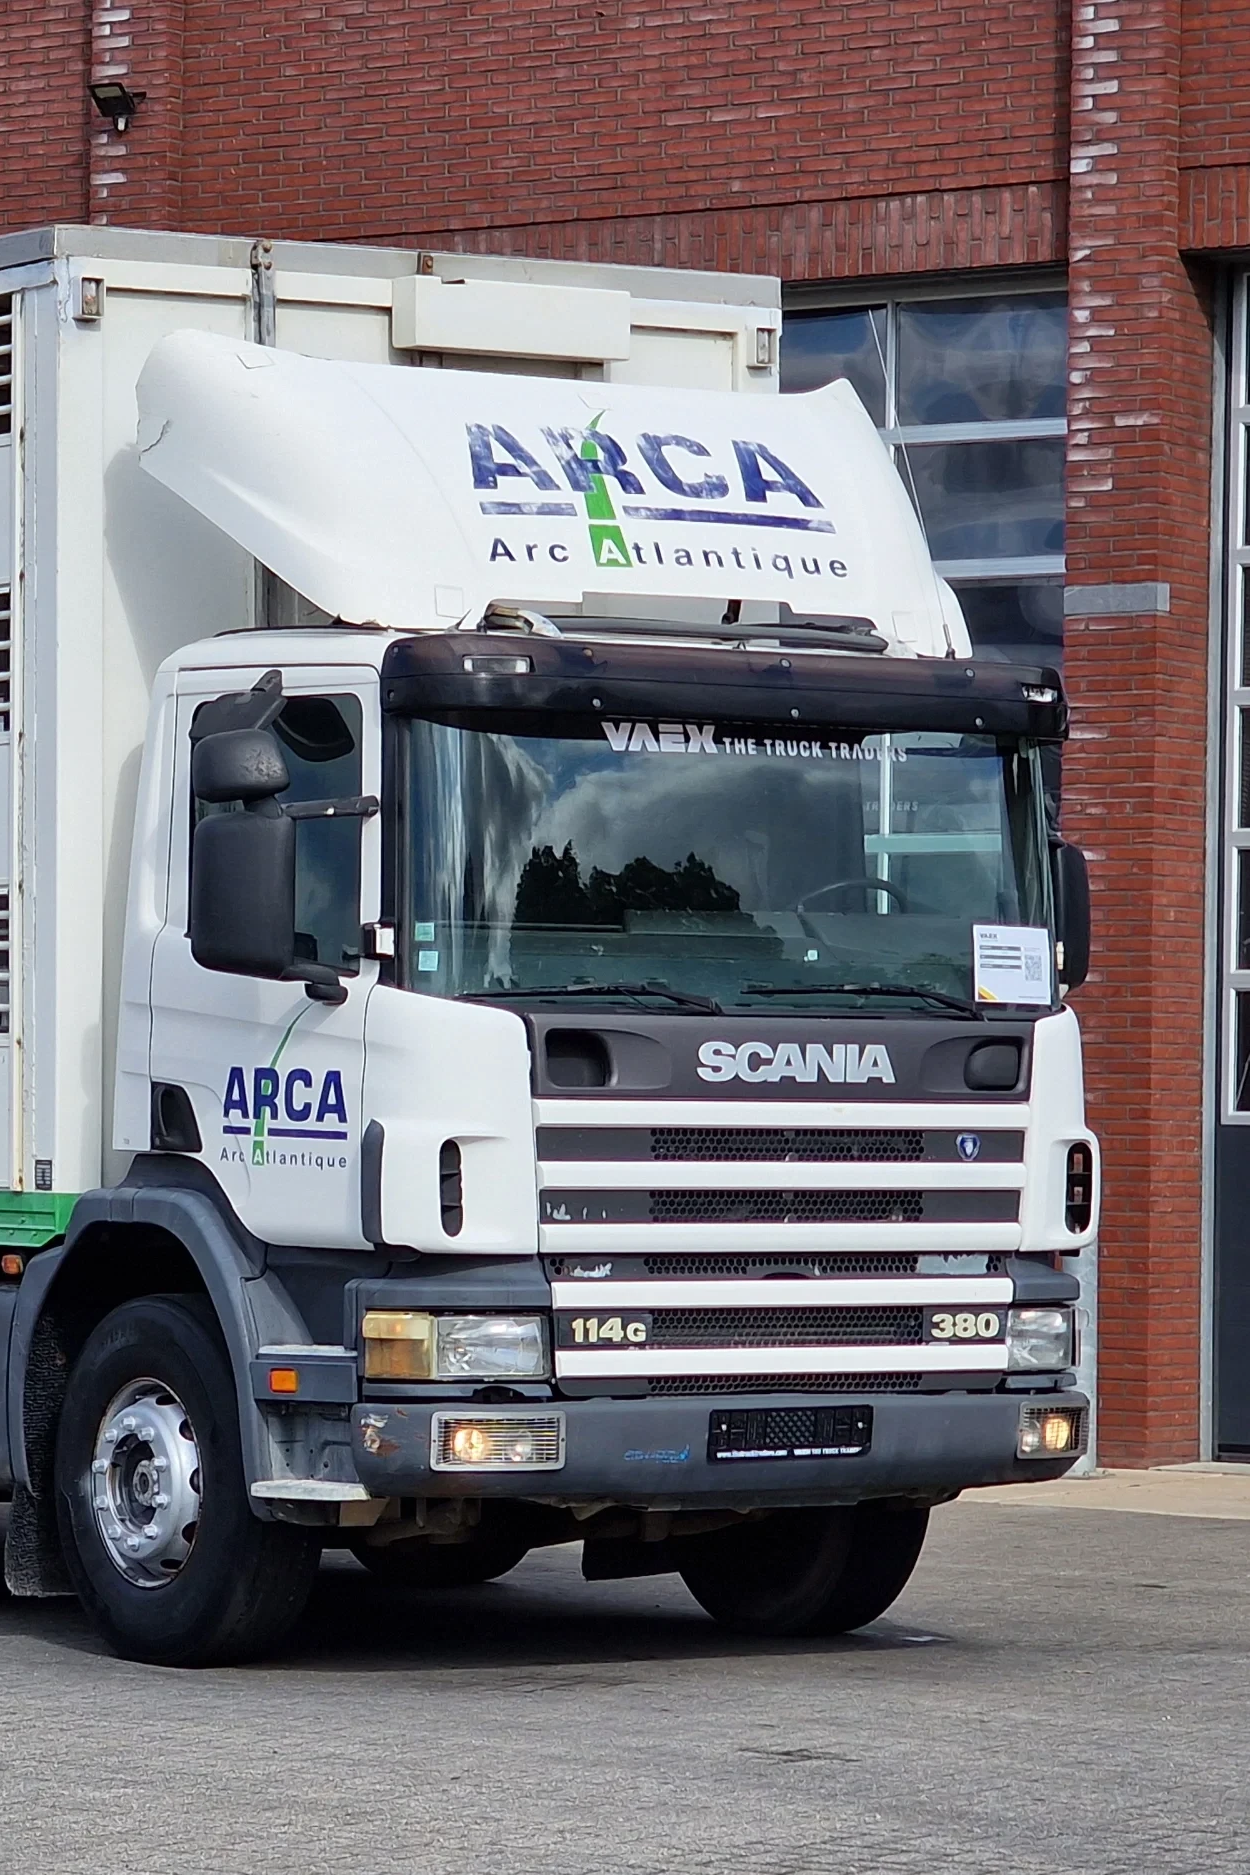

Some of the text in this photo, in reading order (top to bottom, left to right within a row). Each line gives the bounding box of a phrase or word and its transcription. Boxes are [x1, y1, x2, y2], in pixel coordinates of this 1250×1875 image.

[466, 423, 824, 509] ARCA
[489, 537, 848, 579] Arc Atlantique
[601, 722, 718, 754] VAEX
[722, 738, 757, 755] THE
[764, 739, 823, 758] TRUCK
[697, 1041, 895, 1084] SCANIA
[223, 1067, 347, 1123] ARCA
[220, 1147, 347, 1170] Arc Atlantique
[931, 1313, 999, 1338] 380
